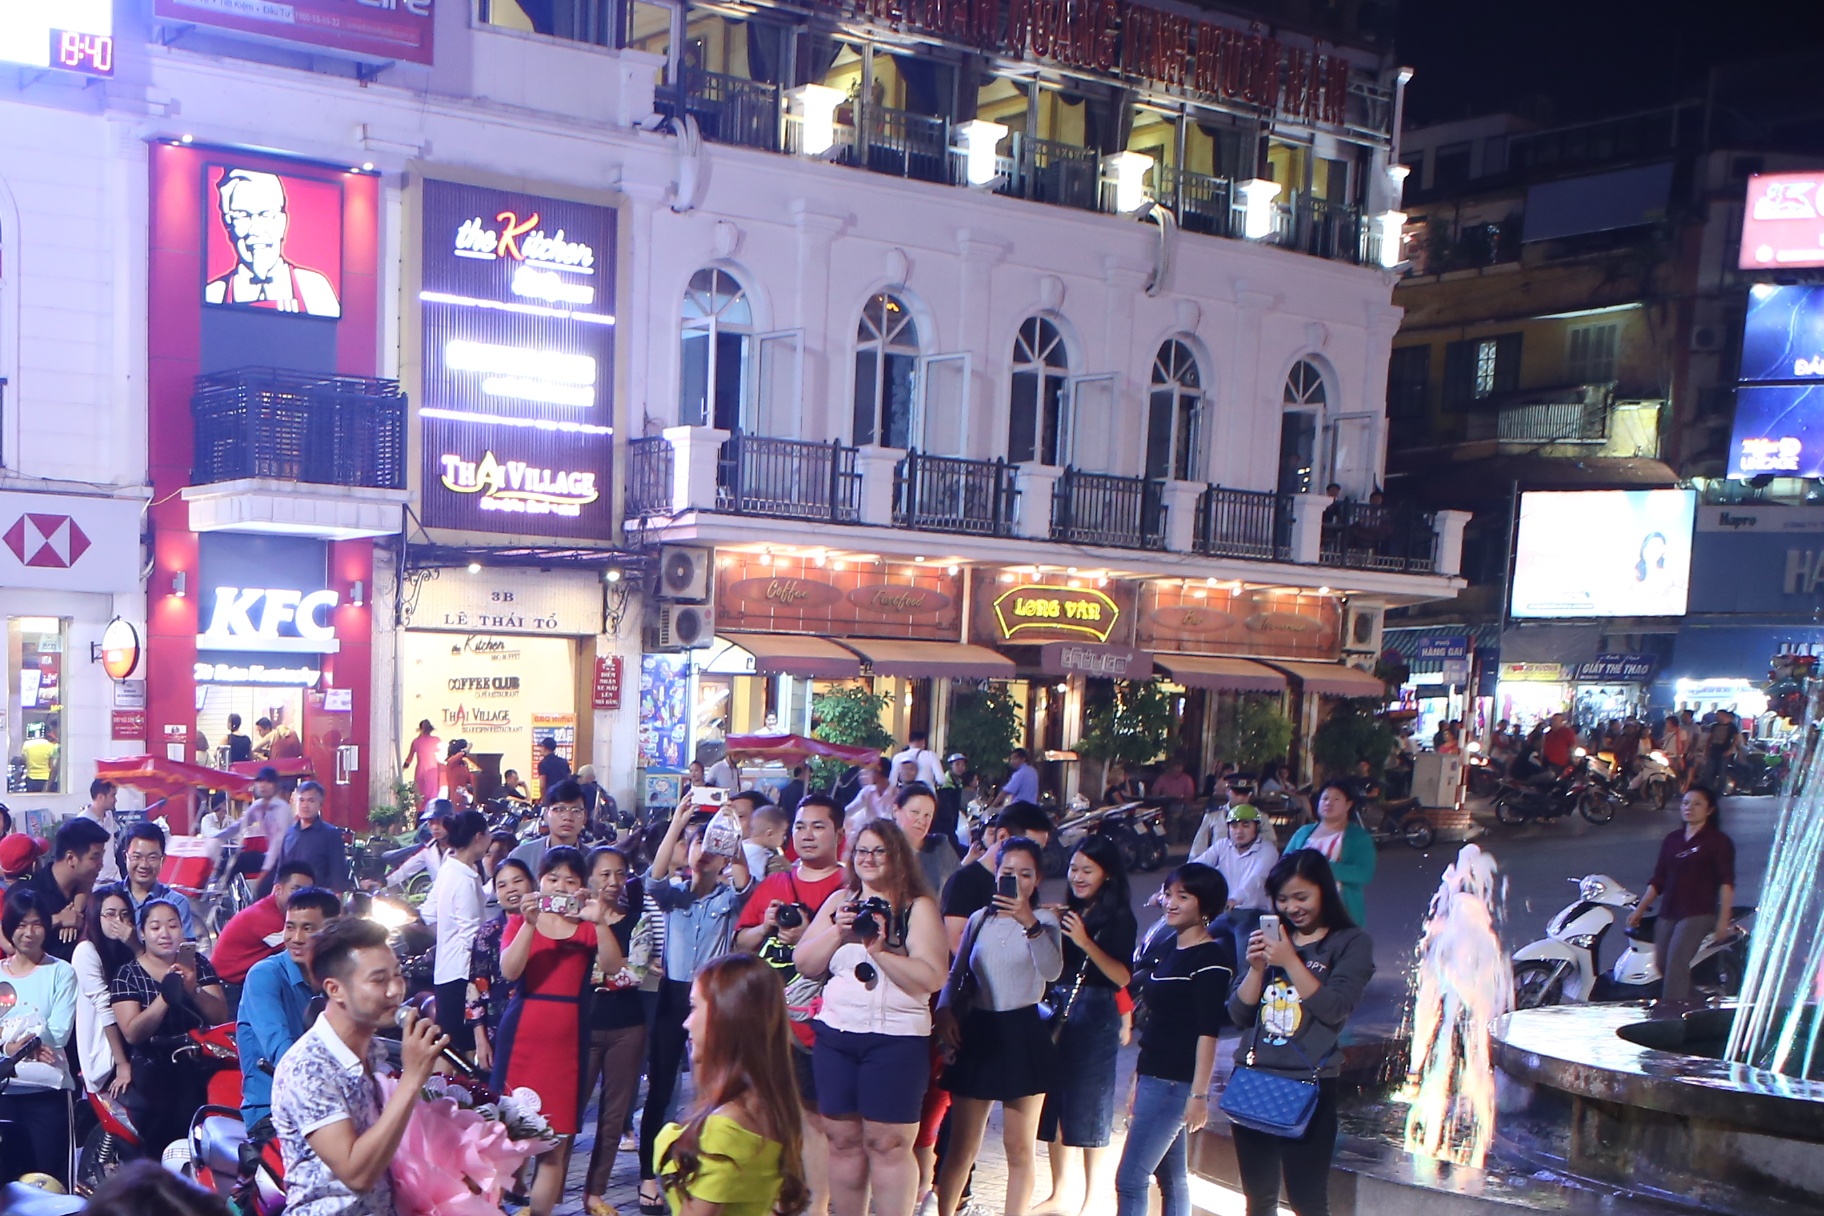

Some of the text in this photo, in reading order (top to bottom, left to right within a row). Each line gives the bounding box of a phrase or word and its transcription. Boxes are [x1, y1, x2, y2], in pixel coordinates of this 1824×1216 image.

[60, 31, 113, 71] 19:40
[491, 591, 514, 602] 3B
[205, 586, 339, 641] KFC
[1014, 598, 1060, 618] LONG
[445, 611, 468, 625] LÊ
[479, 612, 525, 627] THÁI
[447, 676, 520, 691] COFFEE CLUB
[443, 703, 510, 723] THAI VILLAGE
